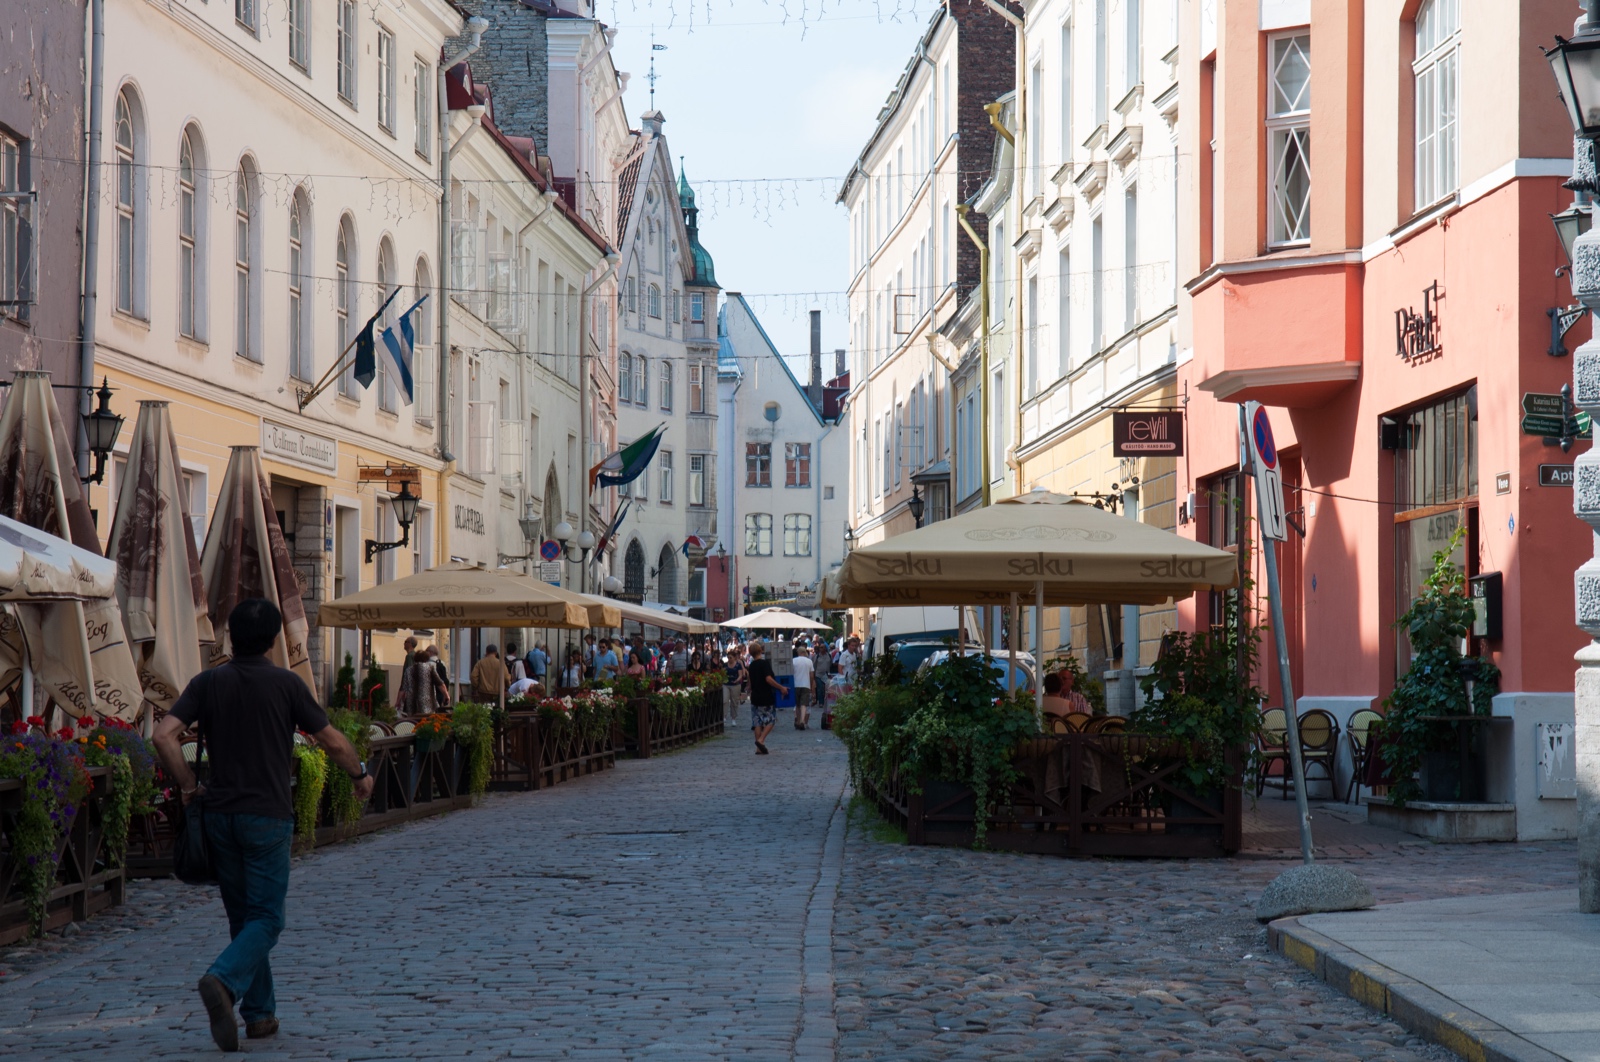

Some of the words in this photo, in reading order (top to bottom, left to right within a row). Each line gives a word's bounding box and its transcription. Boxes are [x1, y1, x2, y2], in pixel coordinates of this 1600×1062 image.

[363, 470, 414, 479] TOSANA
[1551, 469, 1575, 483] Apt
[876, 551, 943, 576] saku
[1007, 551, 1075, 576] saku
[1139, 553, 1207, 579] saku
[338, 603, 381, 621] saku
[422, 601, 465, 618] saku
[506, 601, 549, 618] saku
